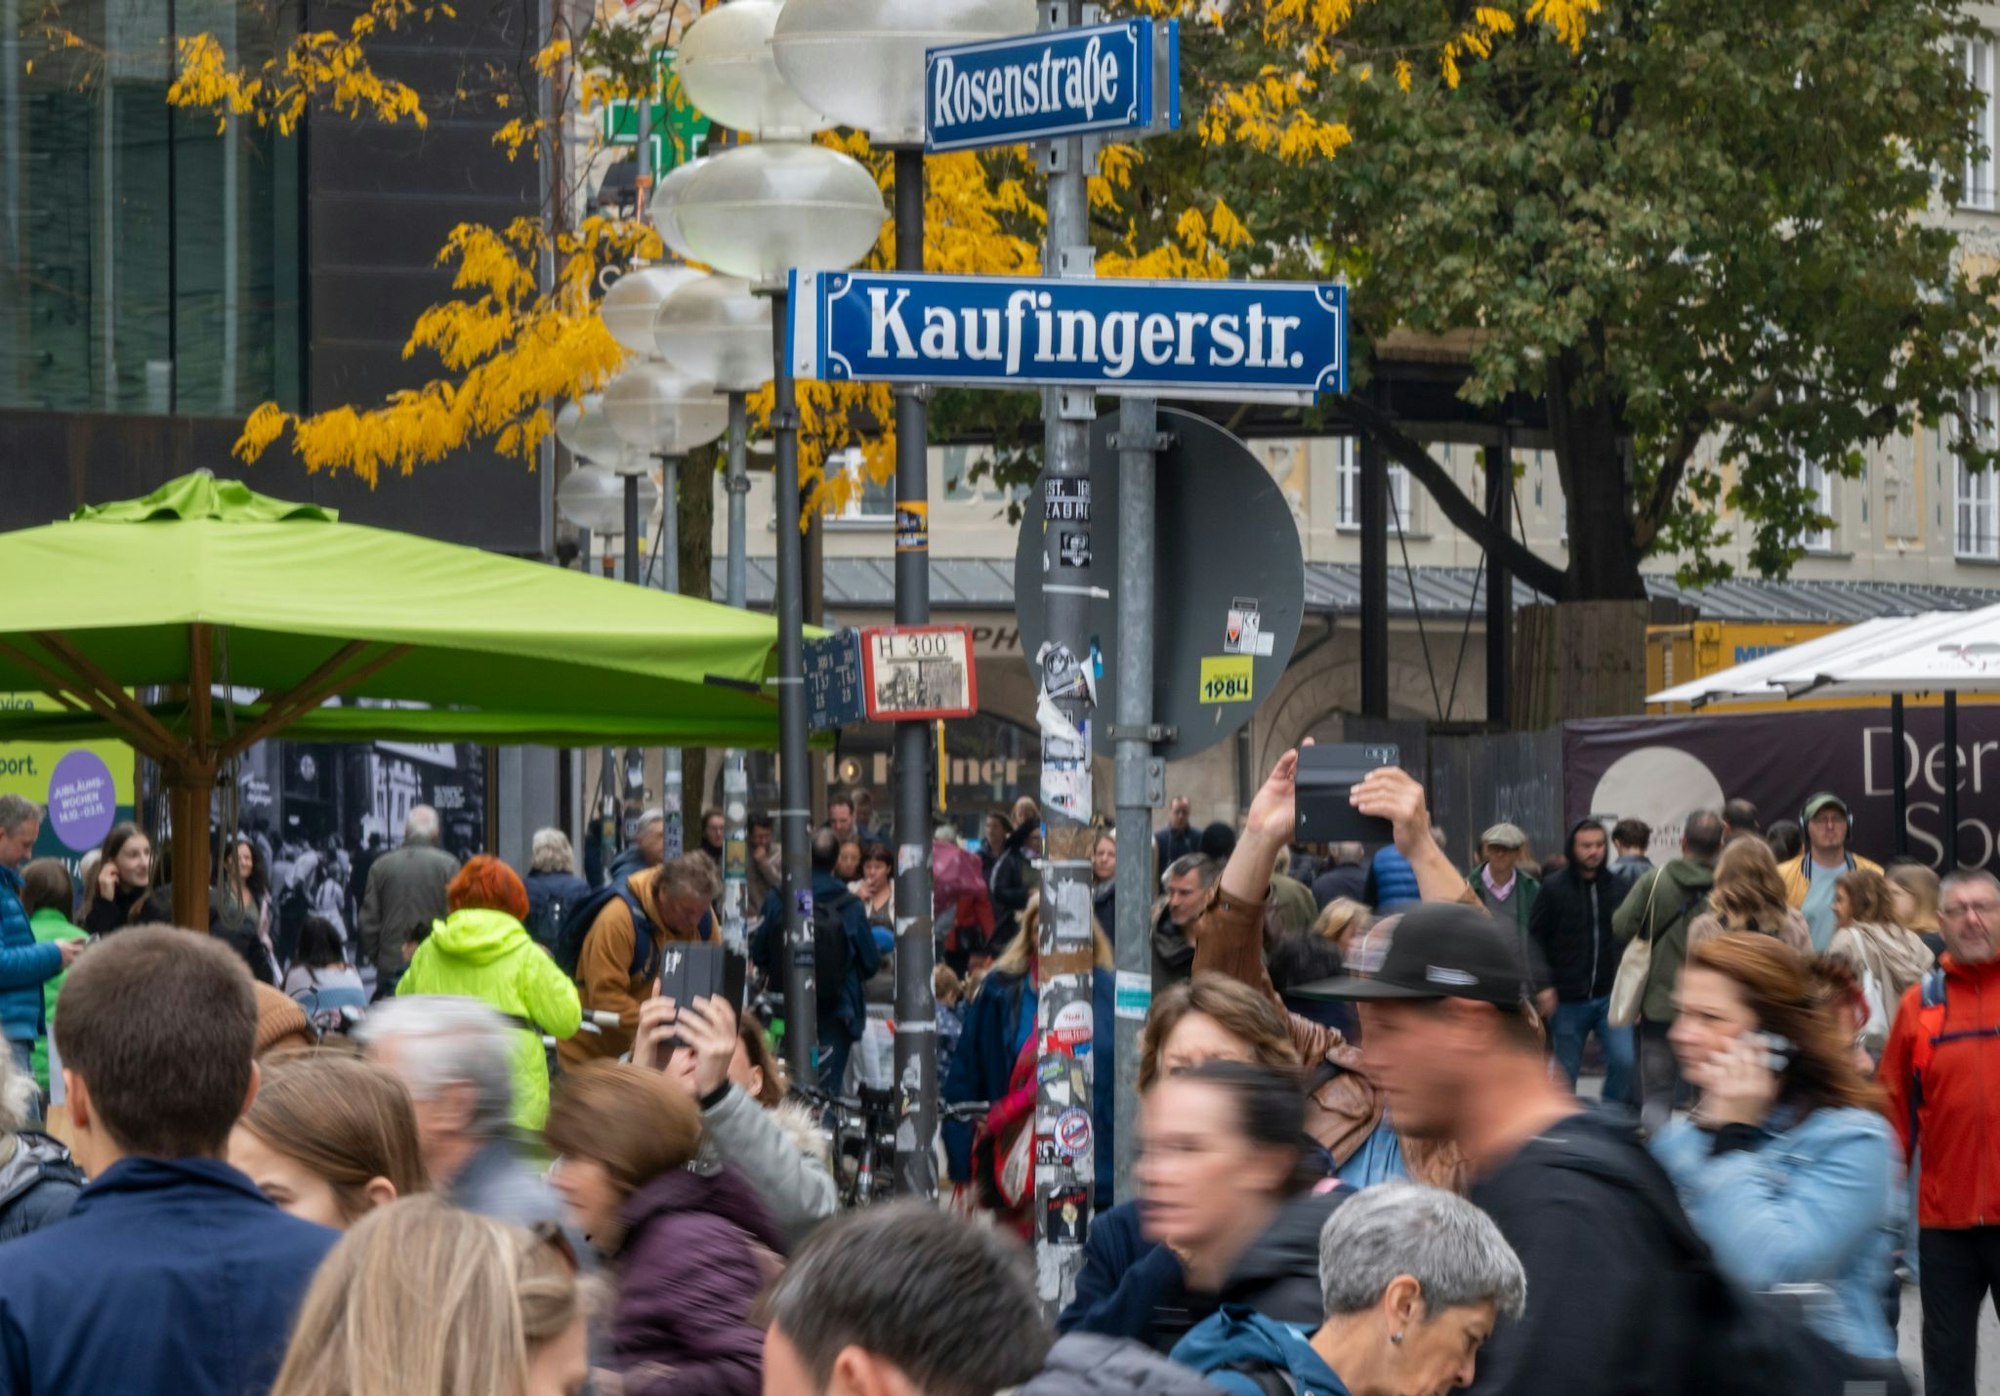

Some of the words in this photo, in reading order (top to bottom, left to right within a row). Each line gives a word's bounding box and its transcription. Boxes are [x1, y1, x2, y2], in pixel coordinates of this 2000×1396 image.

[934, 35, 1119, 128] Rosenstraße
[866, 287, 1304, 378] Kaufingerstr.
[880, 634, 893, 657] H
[908, 633, 946, 657] 300
[1205, 676, 1248, 698] 1984
[1864, 727, 1998, 796] Der
